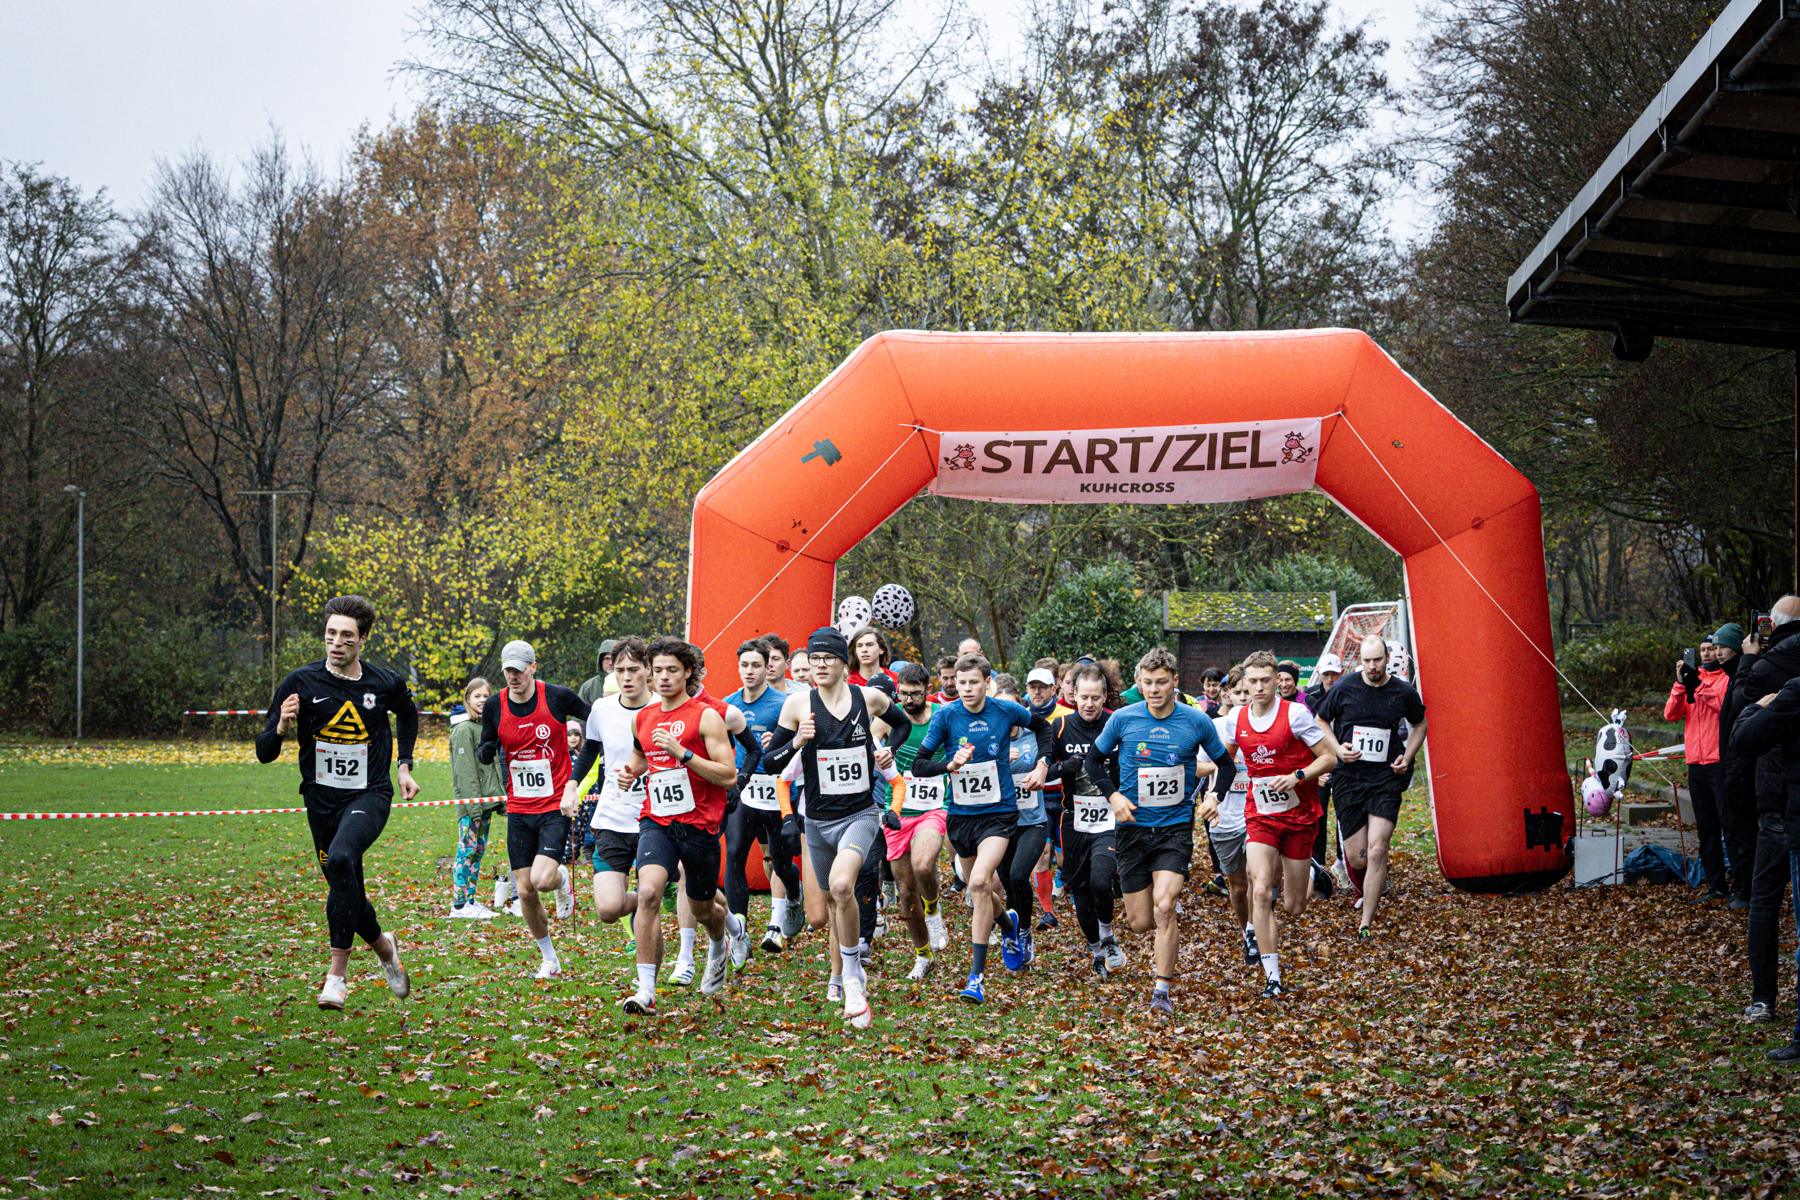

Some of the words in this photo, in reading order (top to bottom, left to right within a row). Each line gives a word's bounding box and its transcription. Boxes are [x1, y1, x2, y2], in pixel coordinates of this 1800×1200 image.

[981, 430, 1277, 474] START/ZIEL
[1080, 482, 1175, 493] KUHCROSS
[537, 725, 549, 738] B
[1358, 737, 1384, 753] 110
[324, 757, 359, 776] 152
[826, 762, 862, 782] 159
[517, 772, 546, 788] 106
[959, 775, 992, 794] 124
[1146, 779, 1179, 797] 123
[654, 784, 684, 804] 145
[748, 785, 776, 800] 112
[909, 784, 938, 801] 154
[1080, 808, 1109, 823] 292
